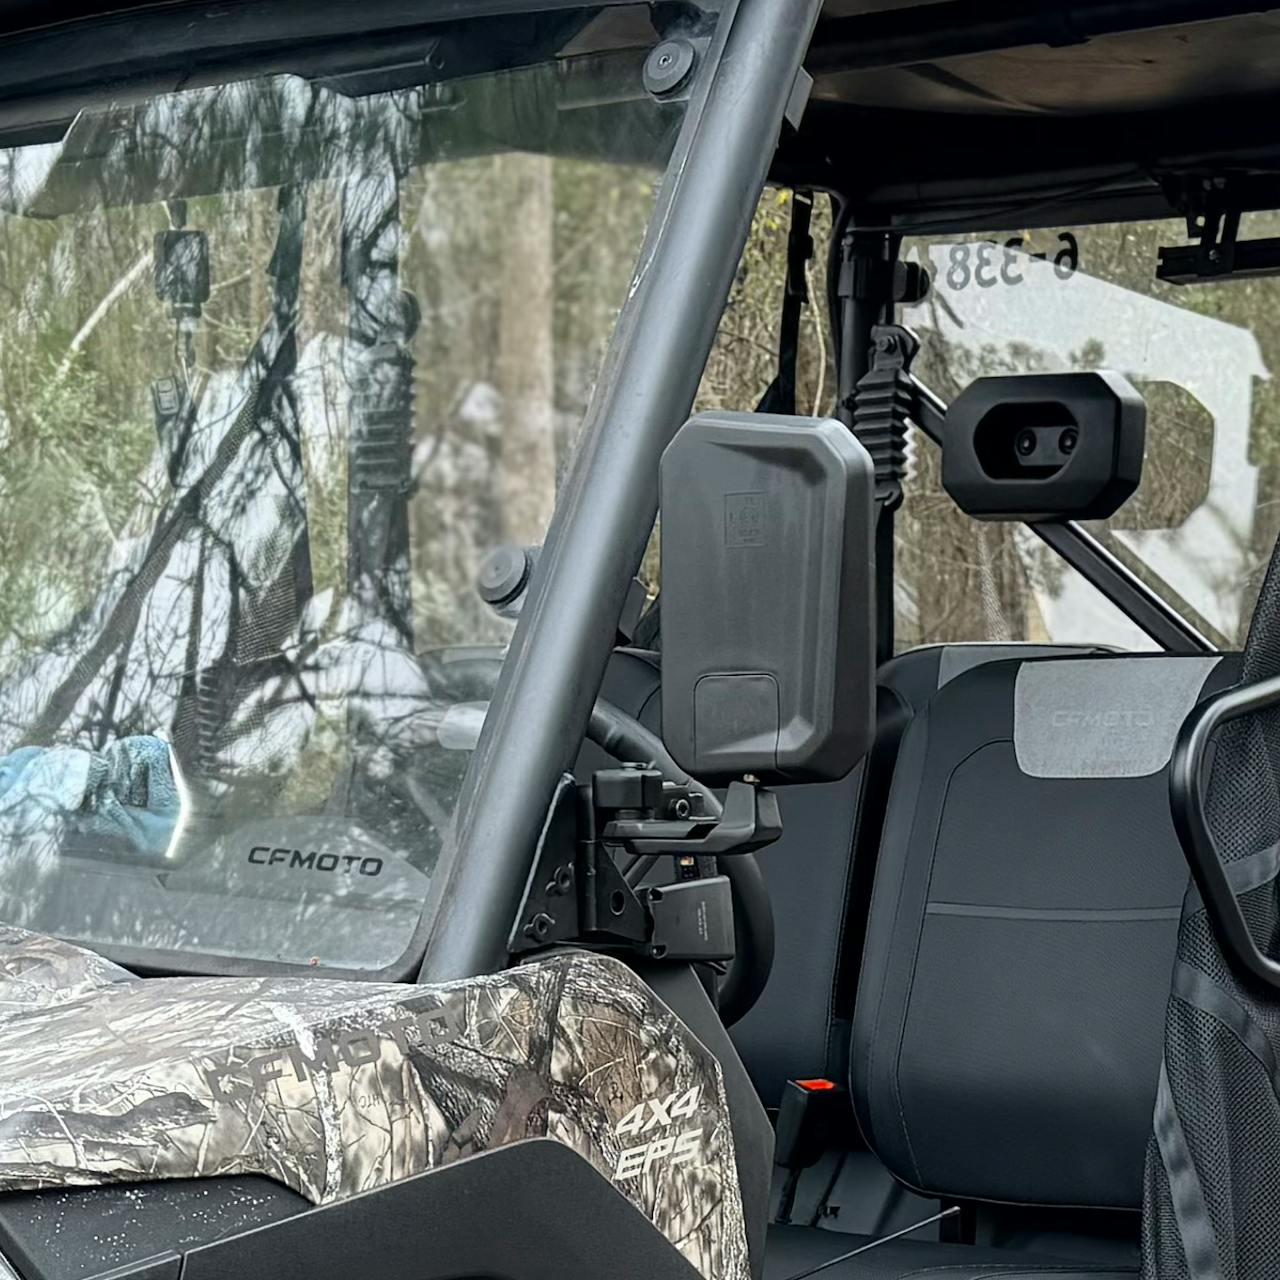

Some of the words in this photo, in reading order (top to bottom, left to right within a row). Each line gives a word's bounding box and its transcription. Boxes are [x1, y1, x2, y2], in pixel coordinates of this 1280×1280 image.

[247, 845, 384, 877] CFMOTO
[207, 1006, 461, 1101] CFMOTO
[614, 1127, 704, 1181] EPS
